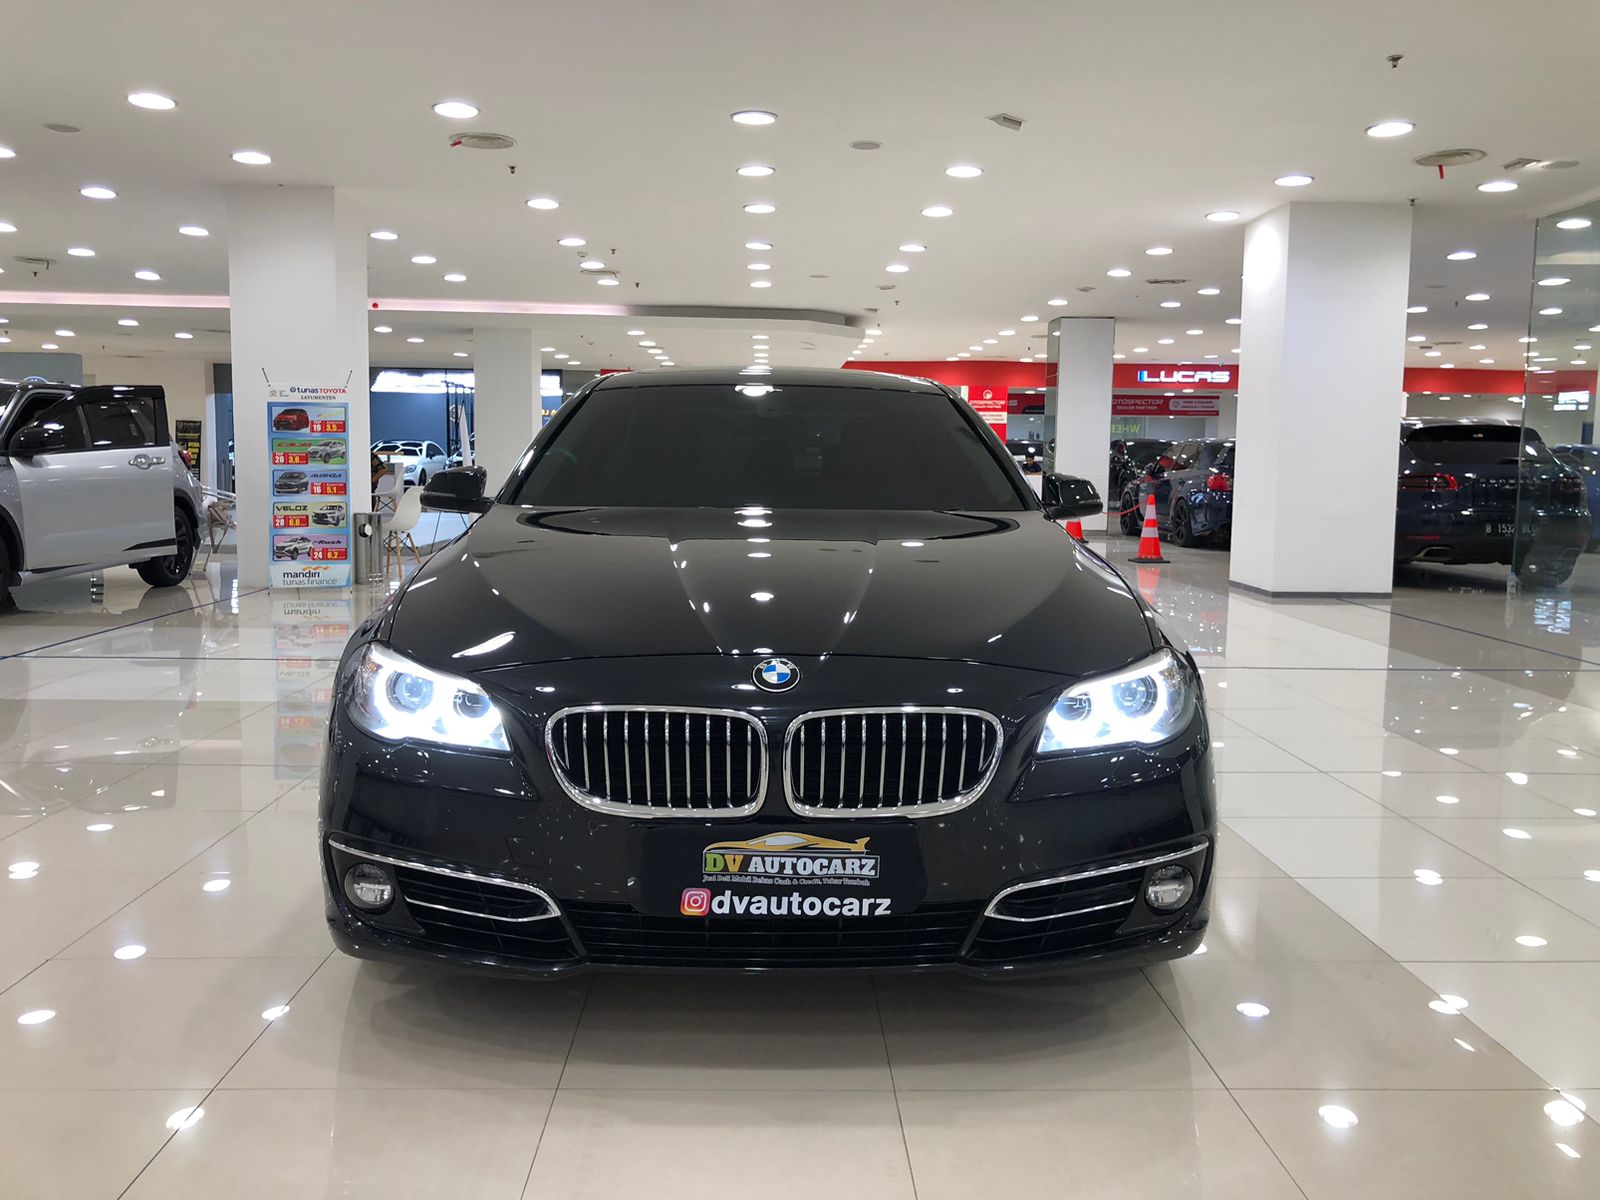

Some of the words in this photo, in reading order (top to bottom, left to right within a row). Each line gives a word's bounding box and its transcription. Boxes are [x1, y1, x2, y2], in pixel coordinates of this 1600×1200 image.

[297, 386, 319, 394] tunas
[283, 570, 320, 579] mandiri
[705, 853, 744, 872] DV
[748, 856, 876, 876] AUTOCARZ
[711, 889, 892, 917] dvautocarz
